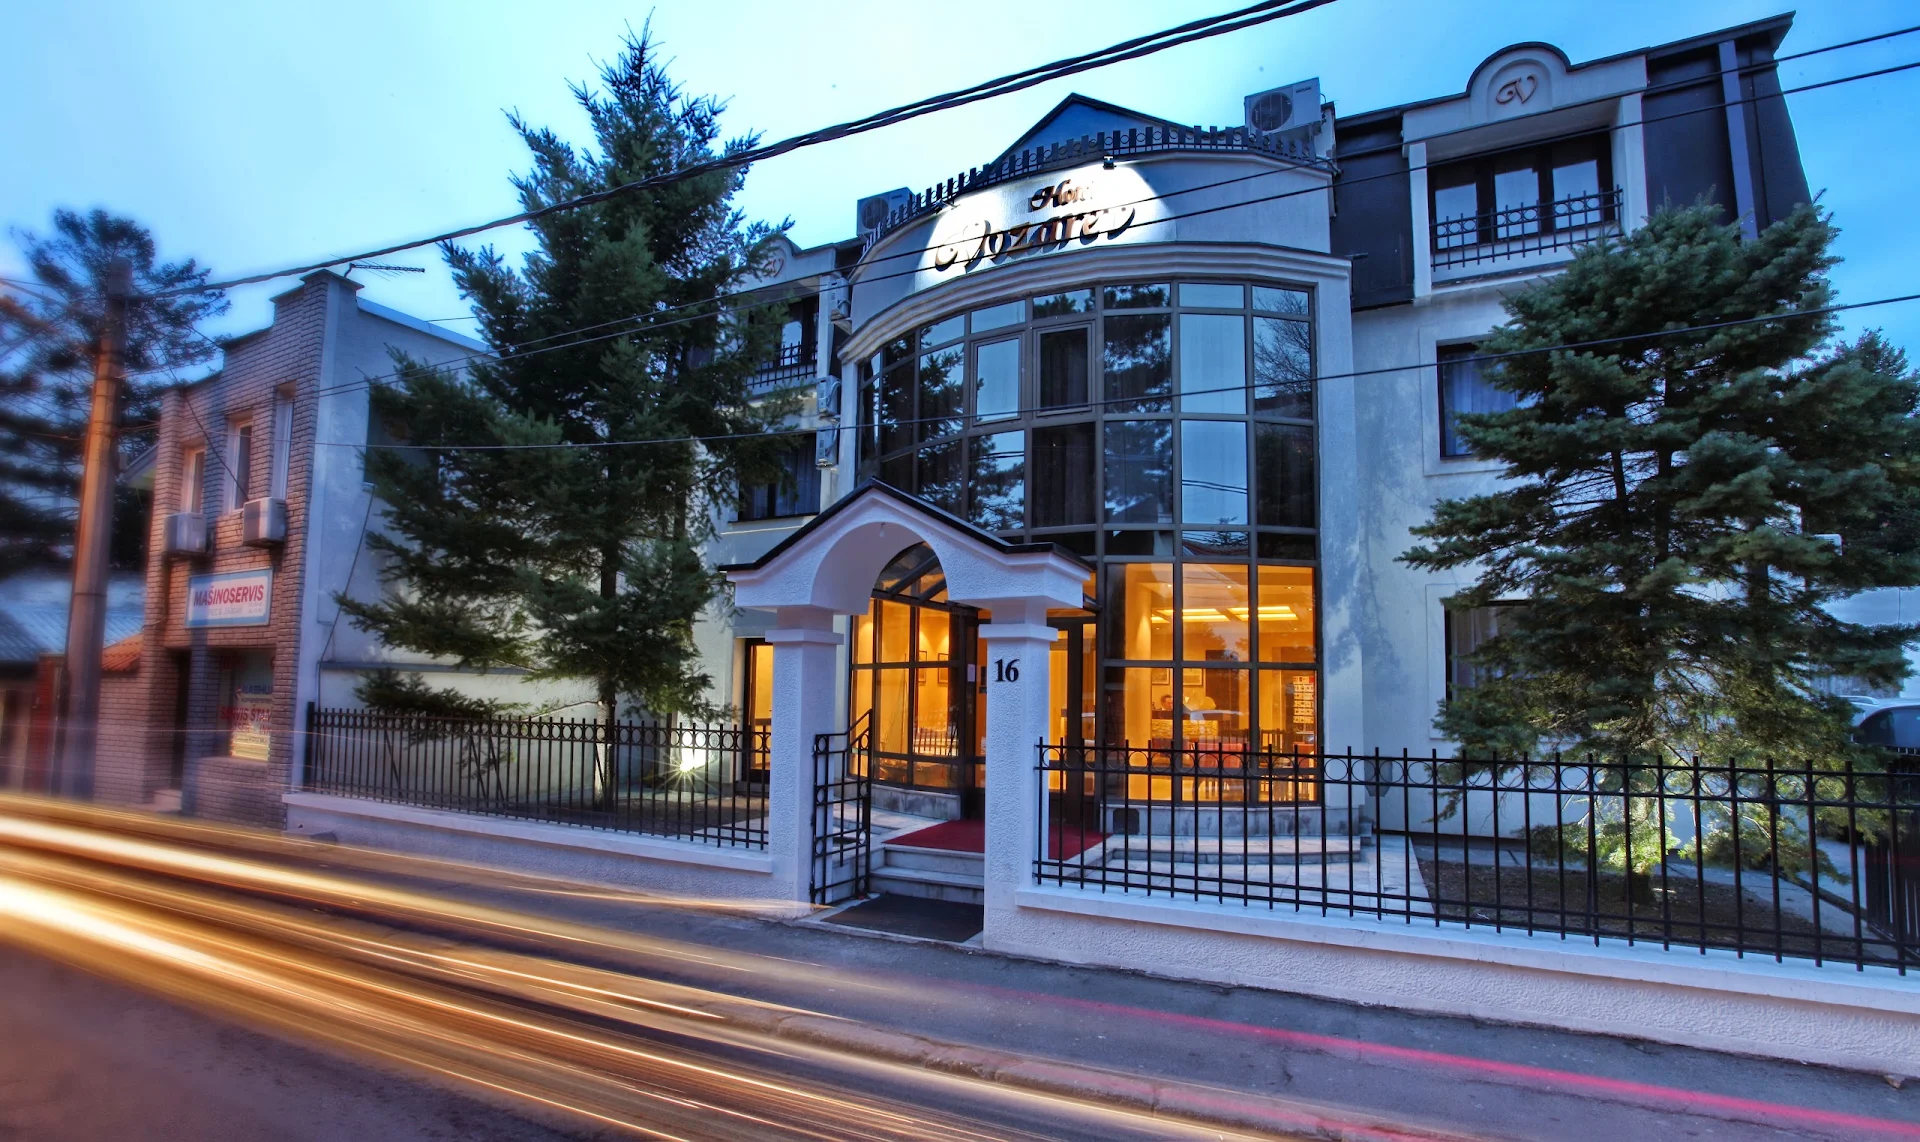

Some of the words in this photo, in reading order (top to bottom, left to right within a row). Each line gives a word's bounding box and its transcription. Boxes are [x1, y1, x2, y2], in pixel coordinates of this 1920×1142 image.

[1029, 178, 1094, 212] Hot
[193, 584, 265, 606] MAŠINOSERVIS
[994, 658, 1020, 683] 16
